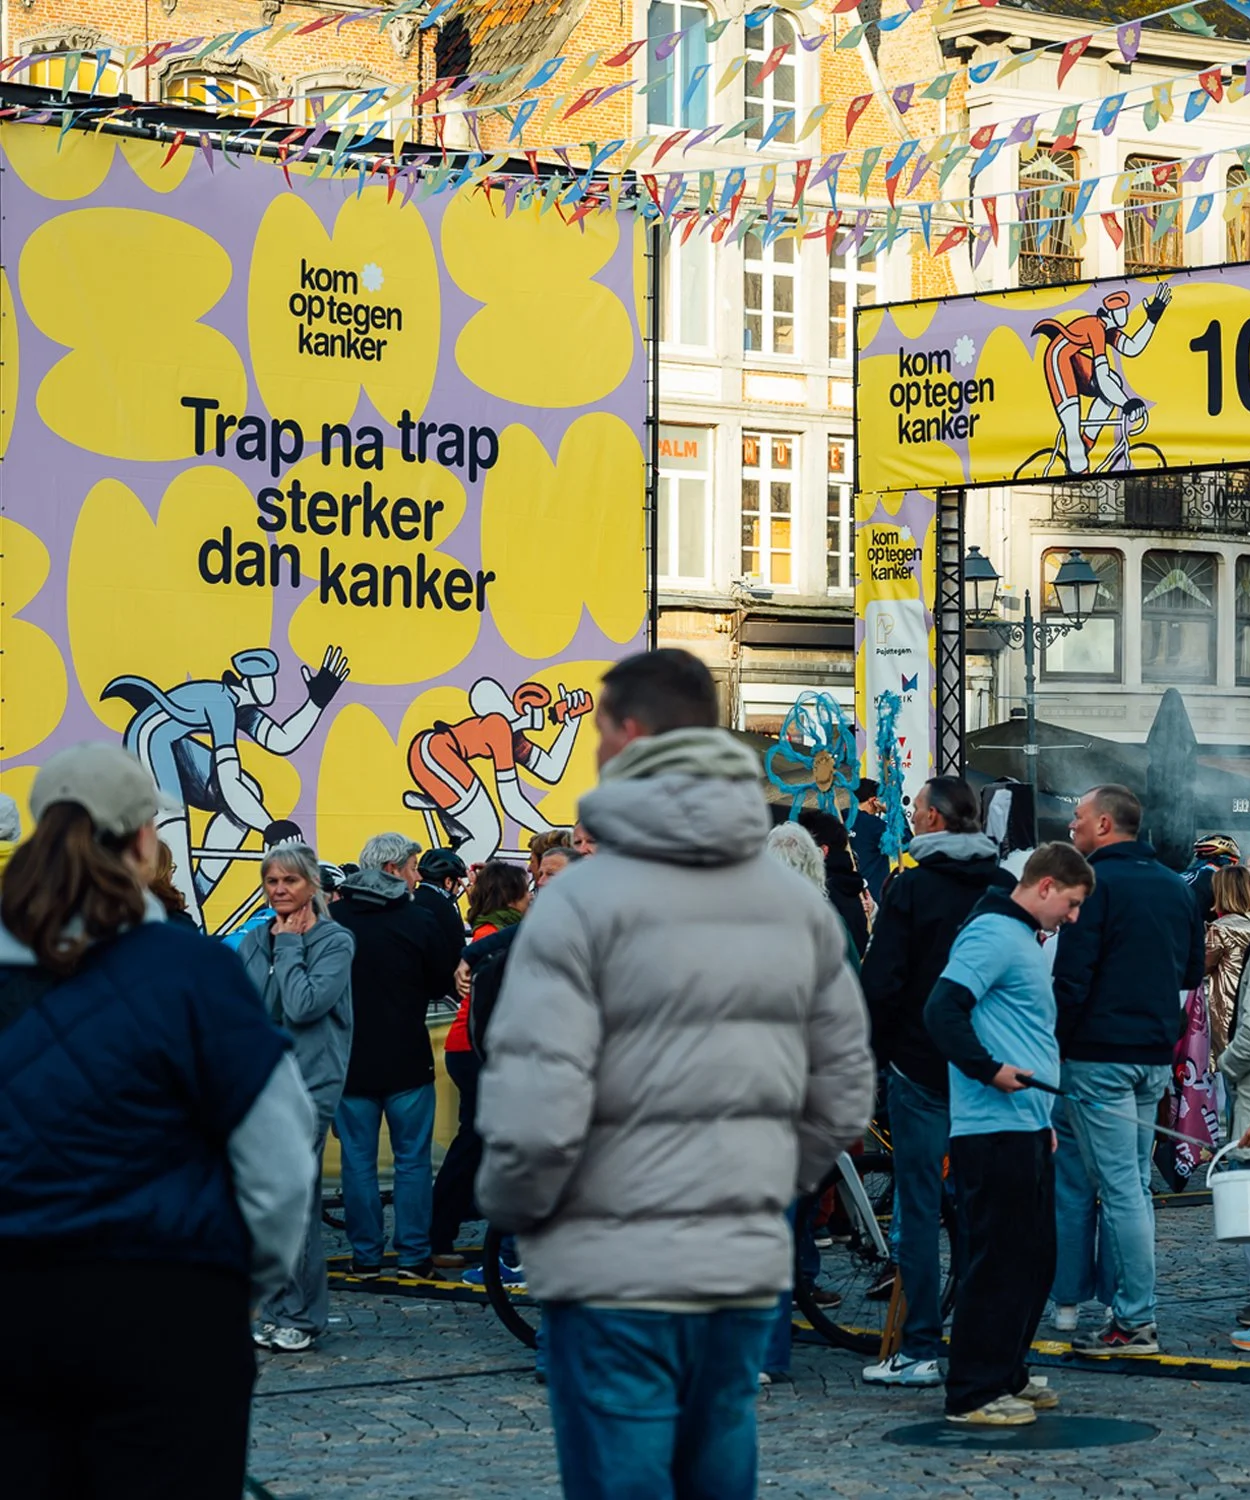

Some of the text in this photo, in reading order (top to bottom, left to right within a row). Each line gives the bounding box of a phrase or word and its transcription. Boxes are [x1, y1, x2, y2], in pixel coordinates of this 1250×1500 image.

[300, 258, 358, 295] kom
[289, 293, 403, 336] op tegen
[298, 323, 388, 362] kanker
[899, 346, 951, 378] kom
[889, 378, 995, 415] op tegen
[180, 396, 500, 483] Trap na trap
[898, 408, 981, 445] kanker
[256, 479, 445, 542] sterker
[867, 546, 923, 566] op tegen
[872, 529, 899, 546] kom
[198, 526, 497, 613] dan kanker
[871, 563, 914, 581] kanker
